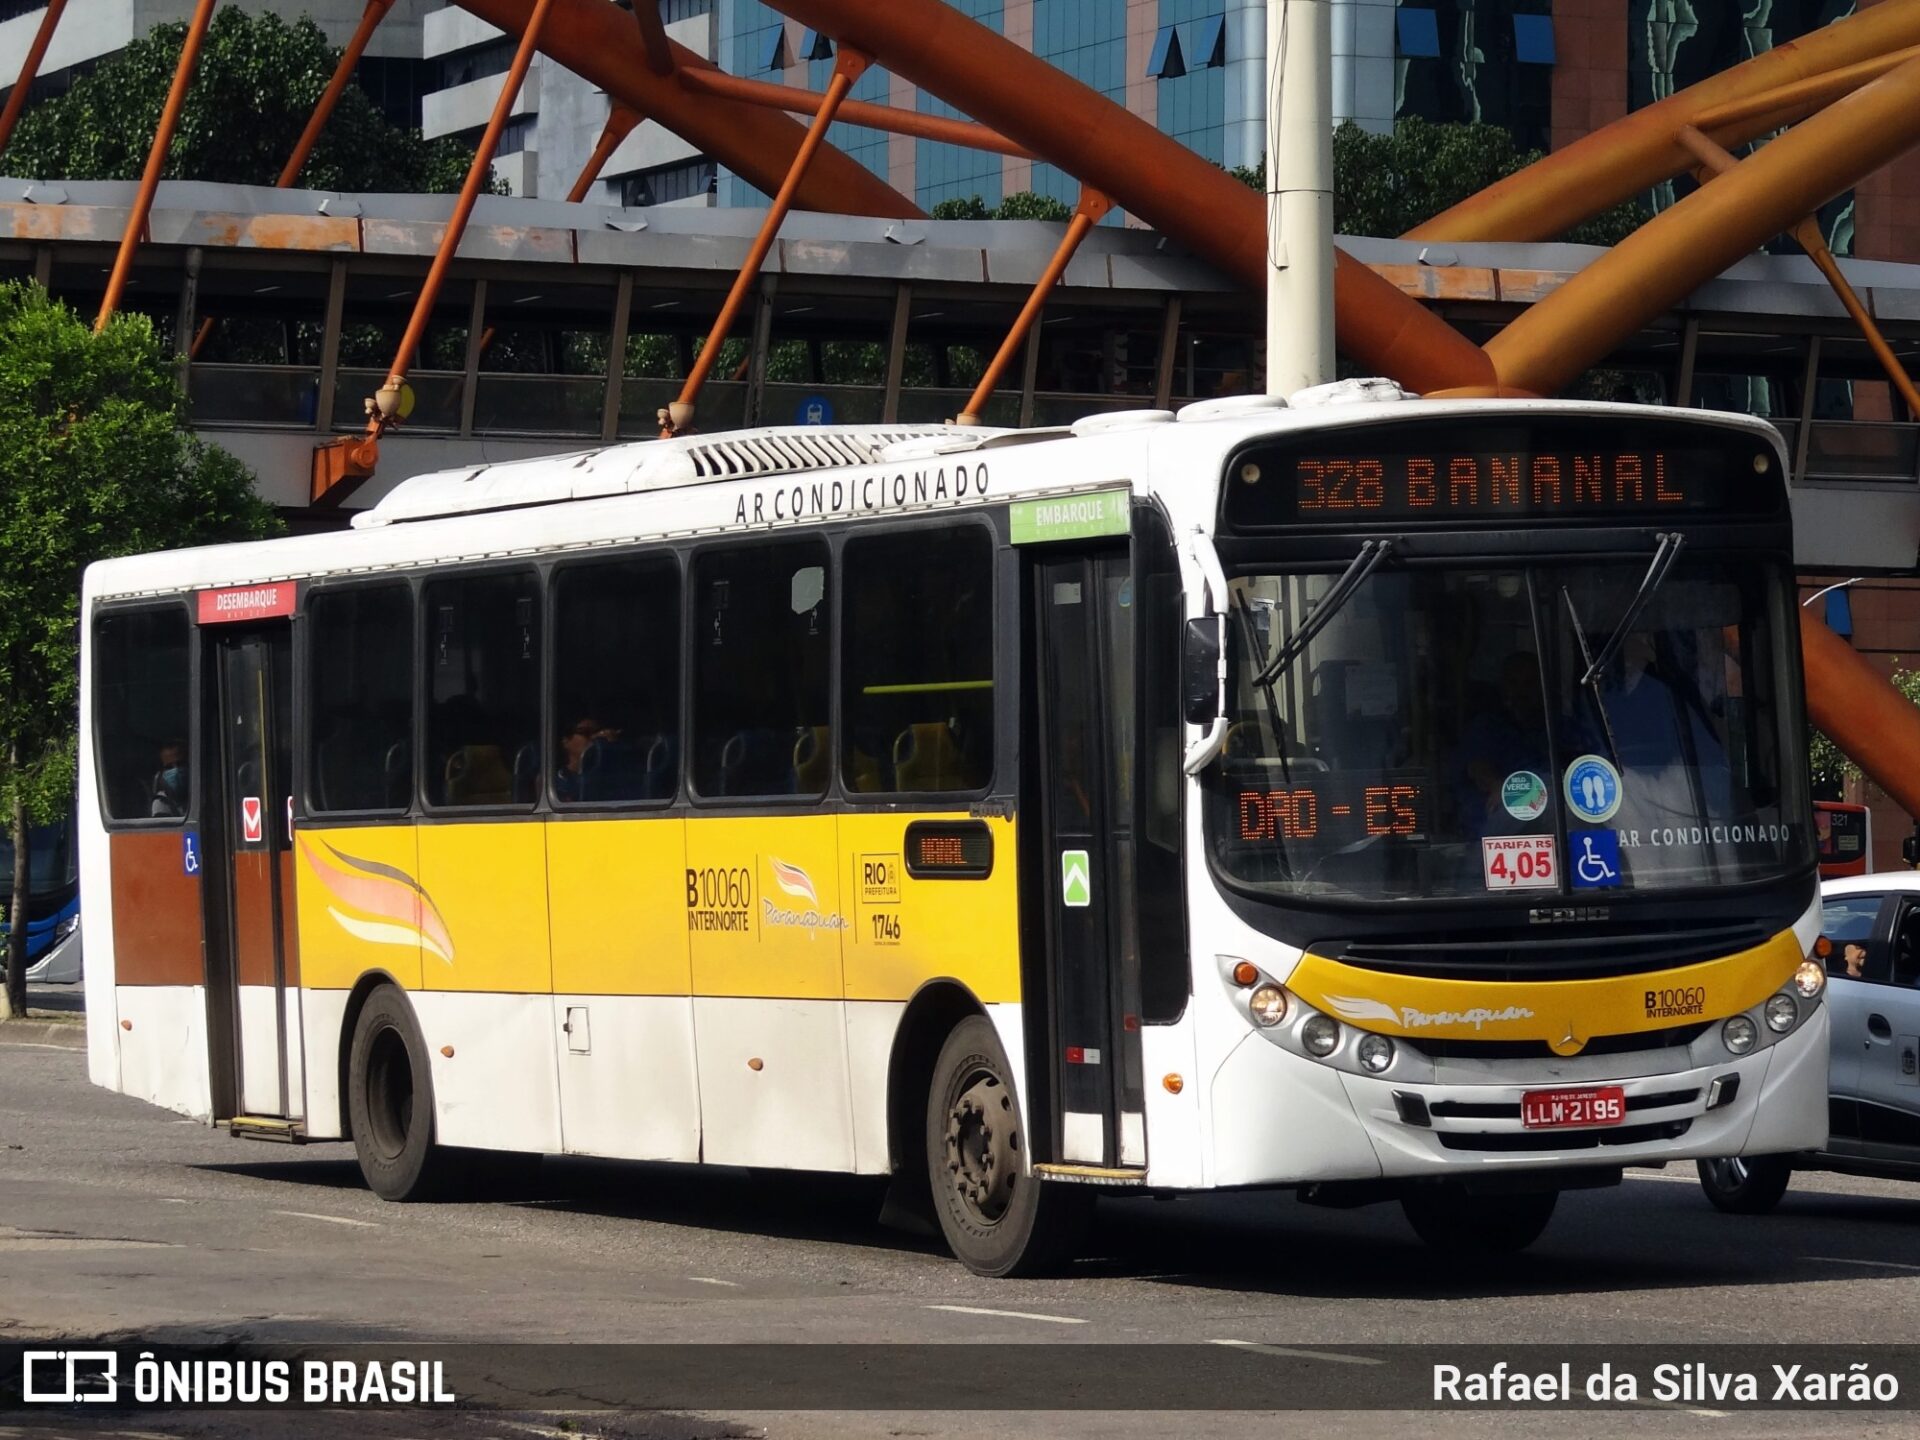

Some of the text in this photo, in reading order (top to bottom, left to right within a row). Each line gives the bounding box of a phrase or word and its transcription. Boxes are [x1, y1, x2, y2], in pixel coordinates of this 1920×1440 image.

[735, 462, 989, 524] AR CONDICIONADO
[1297, 454, 1684, 508] 328 BANANAL
[1036, 500, 1104, 526] EMBARQUE
[216, 588, 277, 609] DESEMBARQUE
[1506, 782, 1531, 791] VERDE
[1365, 785, 1420, 836] ES
[1831, 813, 1849, 827] 321
[1486, 841, 1532, 850] TARIFA
[1618, 824, 1791, 848] AR CONDICIONADO
[864, 862, 887, 885] RIO
[1490, 851, 1552, 885] 4,05
[685, 867, 751, 908] B10060
[864, 886, 898, 896] PREFEITURA
[687, 910, 749, 931] INTERNORTE
[763, 896, 849, 941] Paranapuan
[872, 914, 901, 940] 1746
[1644, 986, 1706, 1009] B10060
[1400, 1005, 1535, 1031] Paranapuan
[1646, 1004, 1704, 1019] INTERNORTE
